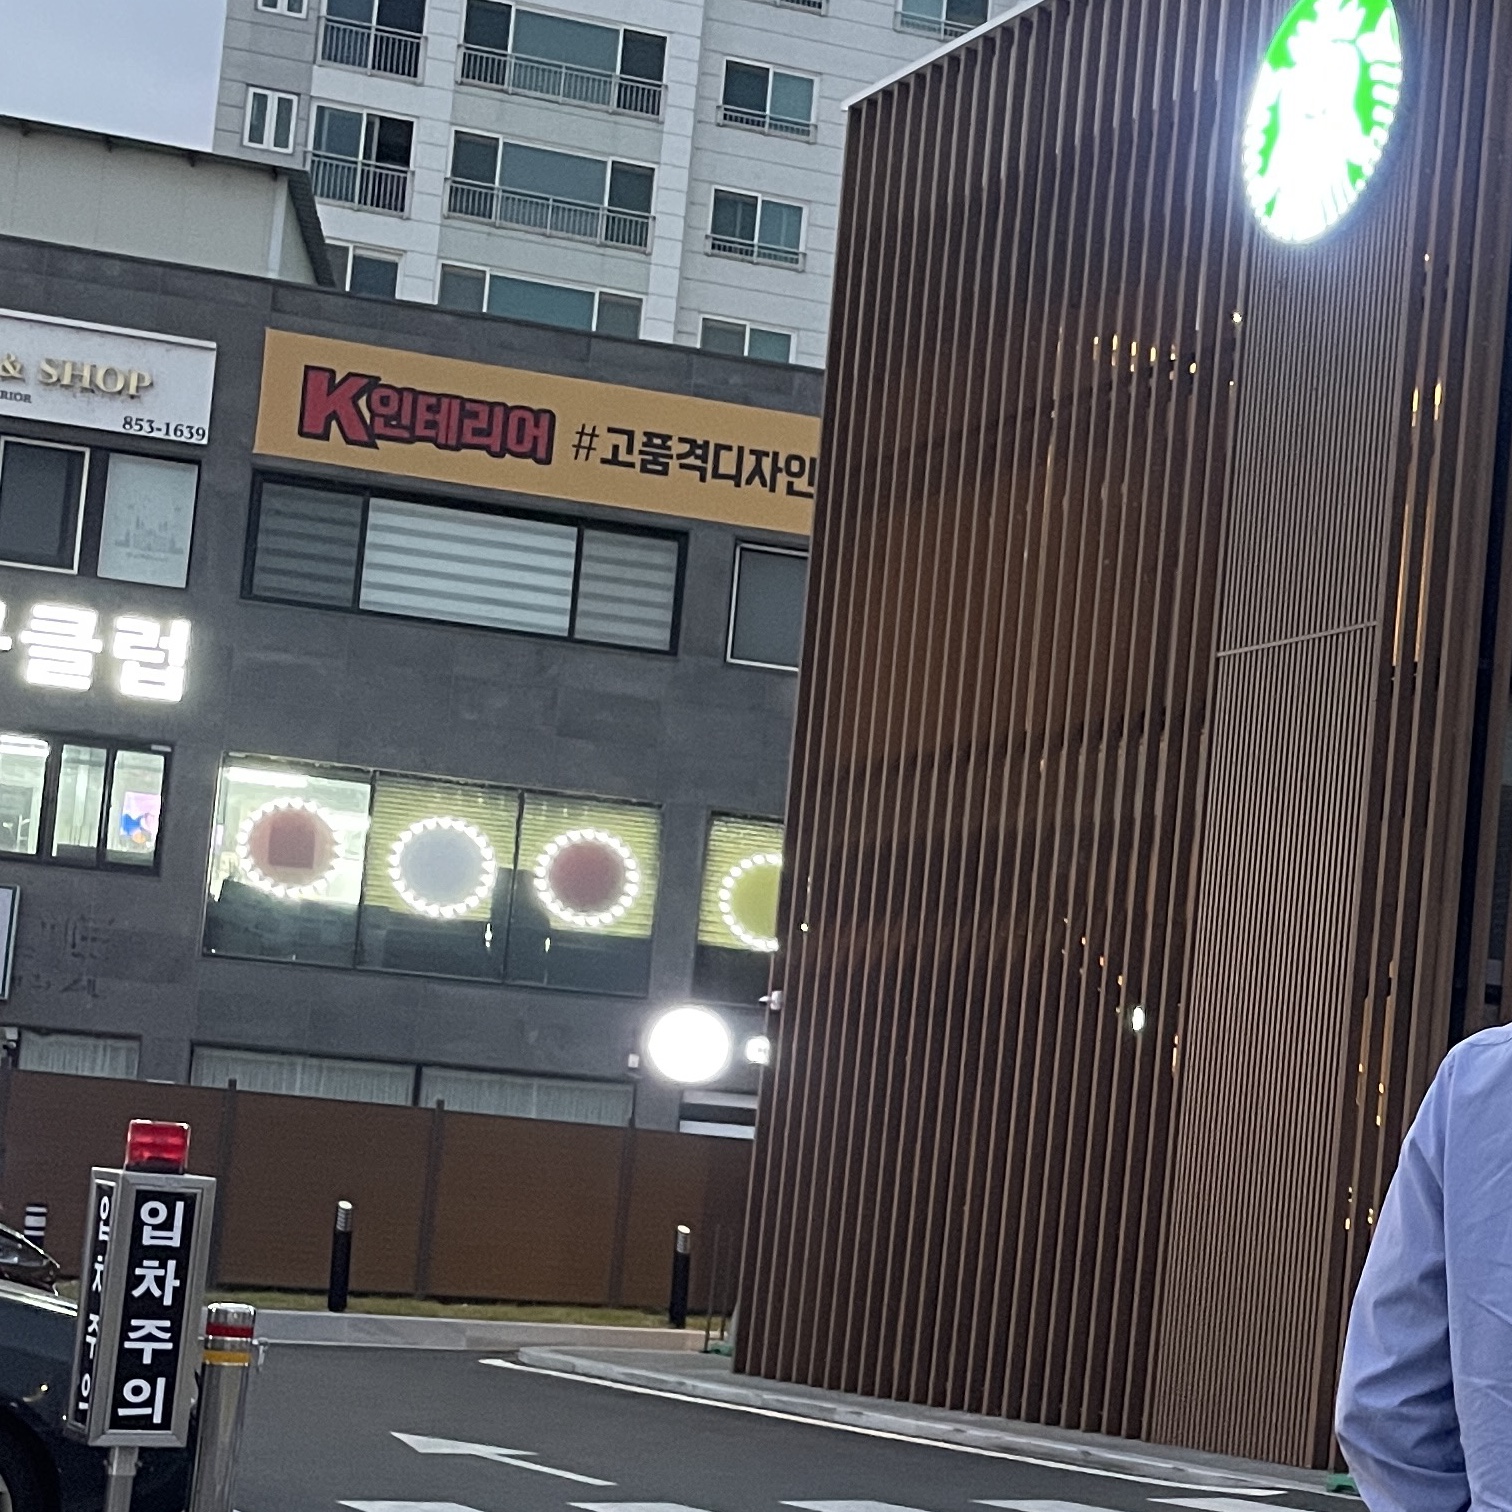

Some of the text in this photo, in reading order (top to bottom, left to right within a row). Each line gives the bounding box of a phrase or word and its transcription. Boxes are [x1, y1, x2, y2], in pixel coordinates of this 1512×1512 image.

[37, 357, 153, 398] SHOP
[122, 415, 207, 442] 853-1639
[298, 364, 556, 466] K인테리어
[117, 1200, 184, 1424] 입차주의
